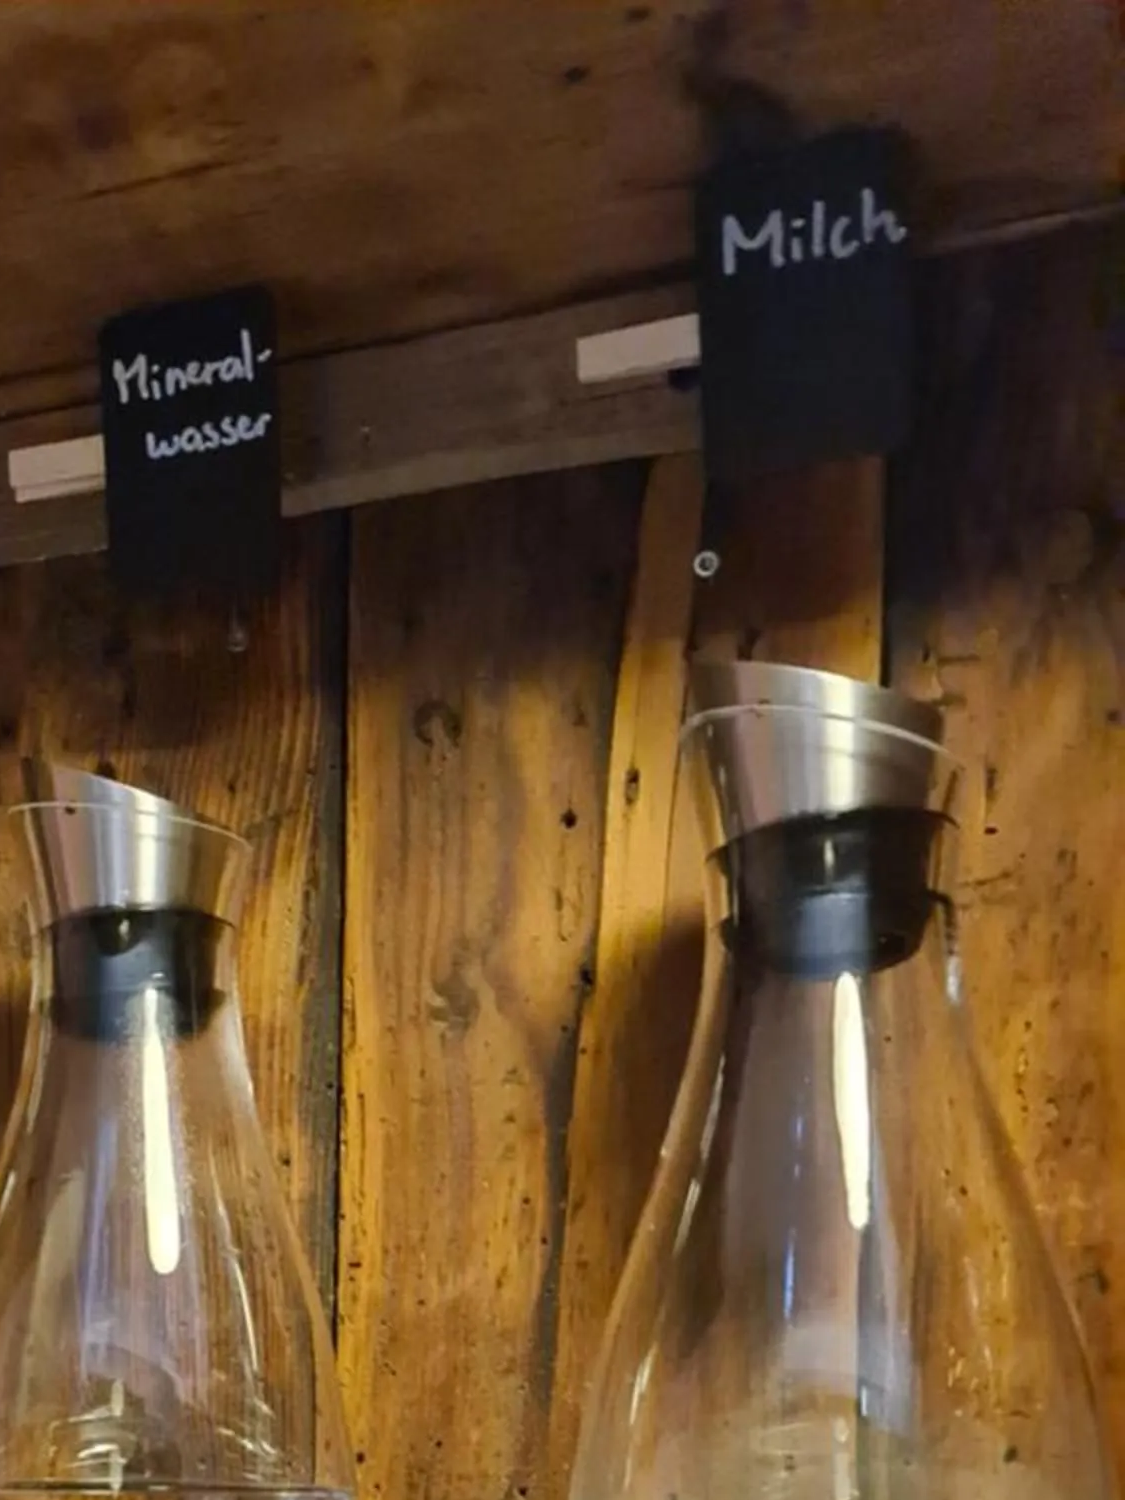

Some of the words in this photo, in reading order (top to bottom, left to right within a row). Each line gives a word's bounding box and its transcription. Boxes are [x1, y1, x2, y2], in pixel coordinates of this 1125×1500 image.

[722, 187, 908, 275] Milch
[112, 328, 273, 404] Mineral-
[145, 413, 272, 459] wasser
